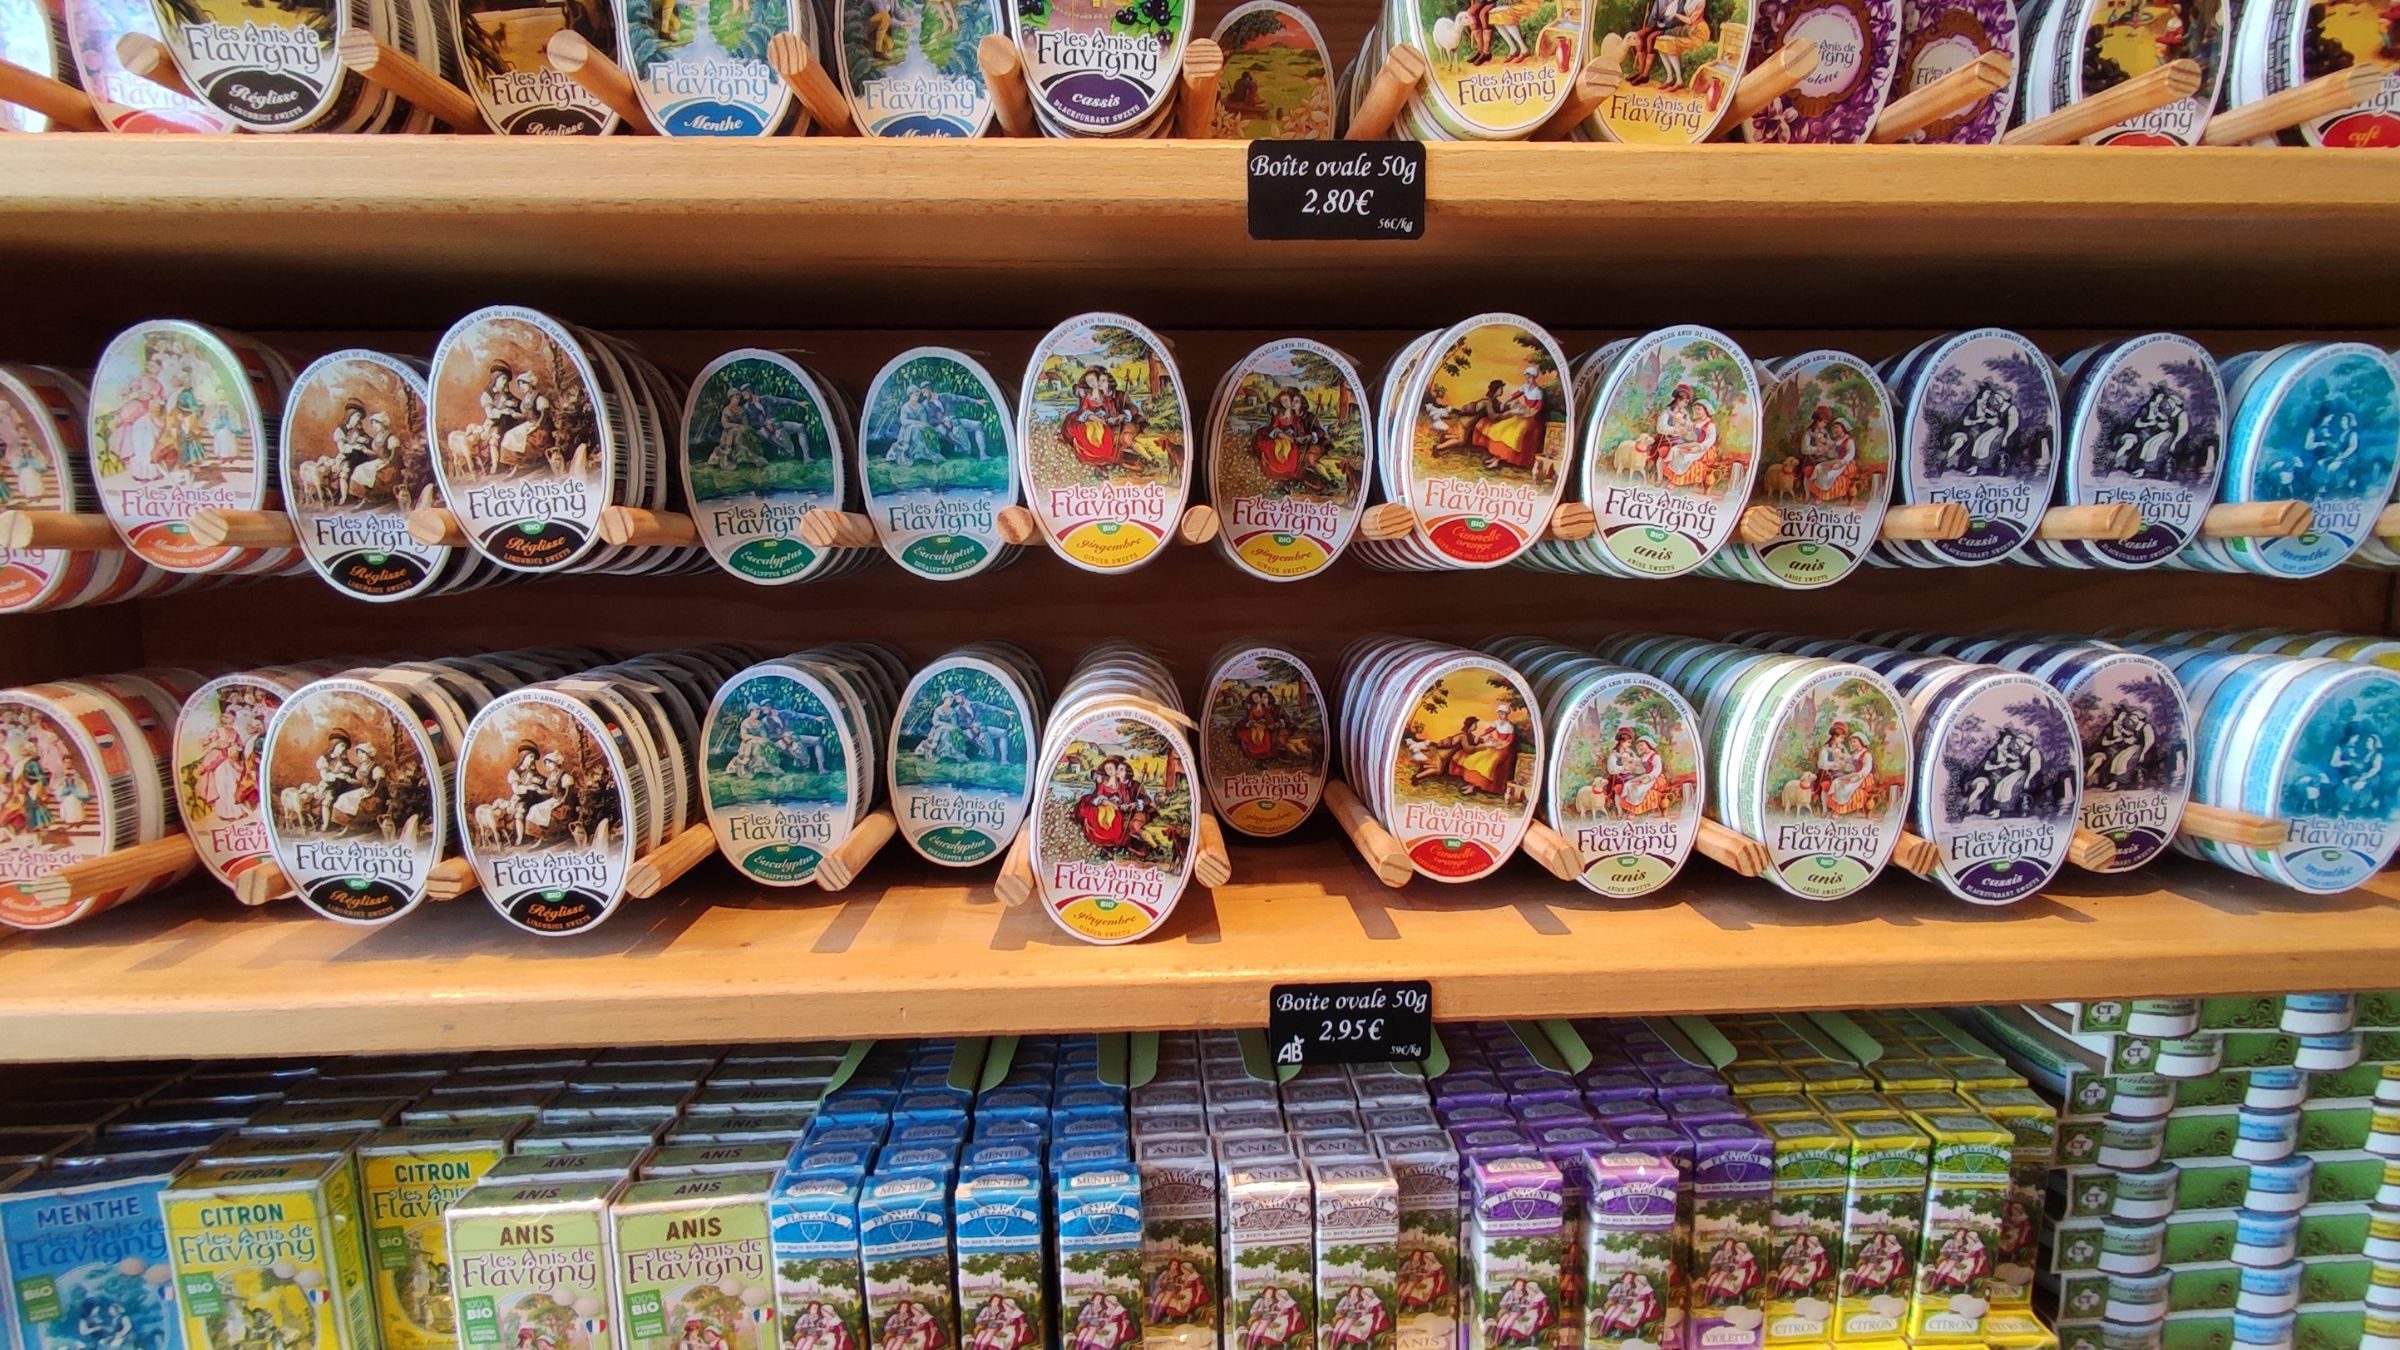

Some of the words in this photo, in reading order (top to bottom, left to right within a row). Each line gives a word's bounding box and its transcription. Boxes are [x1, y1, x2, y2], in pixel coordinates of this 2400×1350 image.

[186, 26, 320, 74] Flavigny
[1062, 32, 1087, 47] les
[1092, 31, 1133, 53] Anis
[1137, 36, 1158, 52] de
[1037, 32, 1158, 79] Flavigny
[649, 62, 769, 103] Flavigny
[1477, 73, 1498, 87] les
[1502, 69, 1534, 87] Anis
[1537, 65, 1555, 79] de
[228, 83, 298, 110] Réglisse
[864, 80, 975, 117] Flavigny
[1071, 91, 1120, 109] cassis
[1457, 77, 1556, 105] Flavigny
[1053, 99, 1110, 125] BLACKCURRANT
[1112, 103, 1141, 123] SWEETS
[1610, 94, 1701, 133] Flavigny
[684, 115, 743, 132] Menthe
[1250, 154, 1309, 177] Boîte
[1315, 153, 1372, 177] ovale
[1377, 155, 1418, 185] 50g
[1302, 188, 1374, 216] 2,80€
[491, 486, 515, 500] les
[520, 479, 561, 500] Anis
[566, 479, 584, 494] de
[1074, 485, 1098, 500] les
[1102, 481, 1139, 500] Anis
[1143, 481, 1164, 498] de
[1449, 479, 1472, 493] les
[1476, 478, 1514, 499] Anis
[1517, 484, 1536, 501] de
[1951, 486, 1972, 499] les
[1976, 482, 2011, 498] Anis
[2013, 483, 2031, 497] de
[2116, 487, 2136, 501] les
[2140, 486, 2173, 502] Anis
[2176, 490, 2193, 503] de
[466, 488, 587, 521] Flavigny
[1050, 488, 1164, 522] Flavigny
[1256, 497, 1277, 512] les
[1280, 497, 1317, 517] Anis
[1320, 501, 1338, 518] de
[1426, 479, 1534, 523] Flavigny
[1631, 489, 1652, 504] les
[1656, 491, 1700, 511] Anis
[1697, 500, 1718, 517] de
[888, 506, 992, 537] Flavigny
[1232, 498, 1337, 538] Flavigny
[1605, 487, 1716, 539] Flavigny
[1783, 507, 1803, 522] les
[1807, 507, 1842, 525] Anis
[1844, 509, 1862, 525] de
[524, 522, 540, 532] BIO
[1102, 524, 1117, 533] BIO
[1470, 520, 1485, 528] BIO
[1277, 535, 1292, 544] BIO
[1452, 526, 1501, 542] Cannelle
[1650, 532, 1665, 540] BIO
[1957, 534, 1999, 548] cassis
[505, 536, 565, 557] Réglisse
[913, 543, 976, 564] Eucalyptus
[1076, 536, 1142, 554] gingembre
[1251, 546, 1313, 563] gingembre
[1455, 540, 1494, 553] orange
[1633, 543, 1673, 561] anis
[2280, 547, 2332, 562] menthe
[740, 547, 803, 569] Eucalyptus
[1788, 559, 1825, 573] anis
[348, 566, 408, 585] Réglisse
[1224, 777, 1309, 802] Flavigny
[930, 794, 950, 808] les
[953, 795, 986, 811] Anis
[988, 797, 1006, 811] de
[751, 812, 771, 826] les
[775, 809, 811, 825] Anis
[812, 809, 830, 824] de
[910, 796, 1005, 832] Flavigny
[729, 815, 832, 845] Flavigny
[1406, 804, 1506, 844] Flavigny
[929, 835, 986, 855] Eucalyptus
[1577, 829, 1677, 857] Flavigny
[1778, 825, 1878, 860] Flavigny
[2286, 818, 2383, 854] Flavigny
[320, 841, 343, 856] les
[348, 841, 389, 858] Anis
[392, 844, 413, 859] de
[1951, 835, 2054, 861] Flavigny
[296, 844, 414, 881] Flavigny
[516, 855, 539, 869] les
[543, 852, 583, 869] Anis
[585, 851, 606, 866] de
[753, 854, 815, 872] Eucalyptus
[493, 859, 608, 890] Flavigny
[1080, 861, 1100, 875] les
[1105, 860, 1141, 880] Anis
[1145, 867, 1164, 882] de
[1611, 869, 1647, 882] anis
[1807, 872, 1843, 885] anis
[2304, 863, 2353, 877] menthe
[1054, 863, 1164, 904] Flavigny
[1982, 873, 2023, 888] cassis
[330, 890, 390, 910] Réglisse
[527, 903, 586, 921] Réglisse
[1073, 911, 1136, 927] gingembre
[1276, 992, 1330, 1012] Boite
[1335, 988, 1387, 1011] ovale
[1391, 989, 1428, 1014] 50g
[2096, 1004, 2114, 1016] CT
[1319, 1018, 1385, 1042] 2,95€
[1277, 1041, 1304, 1063] AB
[2126, 1047, 2144, 1058] CT
[1152, 1144, 1195, 1155] ANIS
[1235, 1143, 1278, 1155] ANIS
[1315, 1142, 1358, 1153] ANIS
[1395, 1140, 1438, 1151] ANIS
[395, 1161, 470, 1183] CITRON
[1075, 1175, 1126, 1186] MENTHE
[1246, 1169, 1290, 1181] ANIS
[1331, 1169, 1375, 1180] ANIS
[674, 1181, 721, 1195] ANIS
[975, 1177, 1026, 1188] MENTHE
[512, 1188, 560, 1200] ANIS
[1498, 1187, 1552, 1202] FLAVIGNY
[37, 1197, 140, 1229] MENTHE
[201, 1203, 284, 1228] CITRON
[500, 1224, 554, 1247] ANIS
[666, 1217, 722, 1241] ANIS
[15, 1233, 167, 1270] Flavigny
[178, 1235, 315, 1266] Flavigny
[462, 1254, 596, 1292] Flavigny
[628, 1251, 763, 1285] Flavigny
[467, 1307, 493, 1321] BIO
[632, 1302, 659, 1317] BIO
[1774, 1324, 1820, 1337] CITRON
[1850, 1320, 1892, 1332] CITRON
[1929, 1319, 1974, 1331] CITRON
[1400, 1336, 1440, 1348] ANIS
[1705, 1333, 1755, 1345] VIOLETTE
